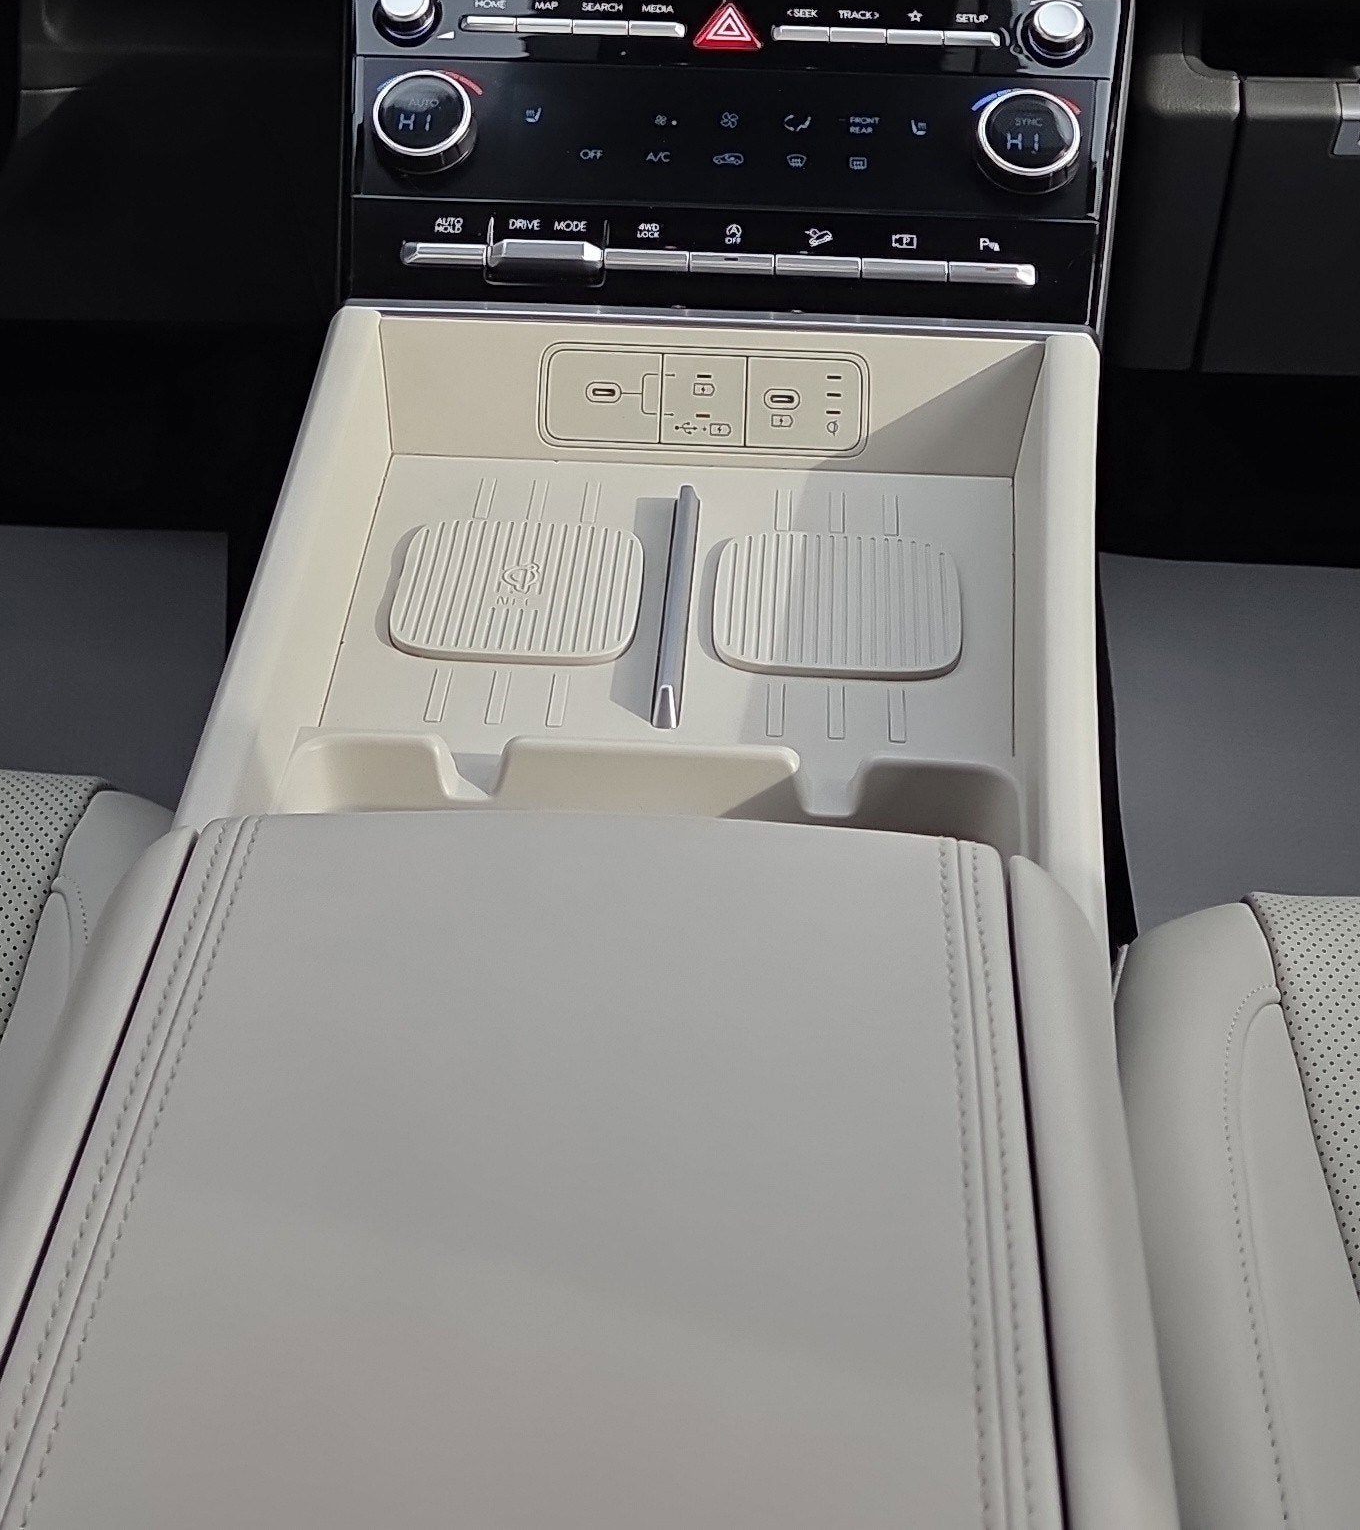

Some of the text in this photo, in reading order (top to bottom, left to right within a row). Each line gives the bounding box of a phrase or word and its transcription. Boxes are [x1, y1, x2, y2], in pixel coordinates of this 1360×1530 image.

[475, 0, 507, 10] HOME
[534, 1, 558, 10] MAP
[581, 2, 623, 13] SEARCH
[641, 3, 674, 14] MEDIA
[955, 13, 989, 24] SETUP
[849, 116, 879, 125] FRONT
[849, 126, 873, 134] REAR
[579, 149, 603, 160] OFF
[646, 151, 671, 163] A/C
[436, 217, 463, 226] AUTO
[508, 219, 588, 232] DRIVE MODE
[435, 225, 462, 234] HOLD
[637, 231, 660, 239] LOCK
[724, 236, 742, 245] OFF
